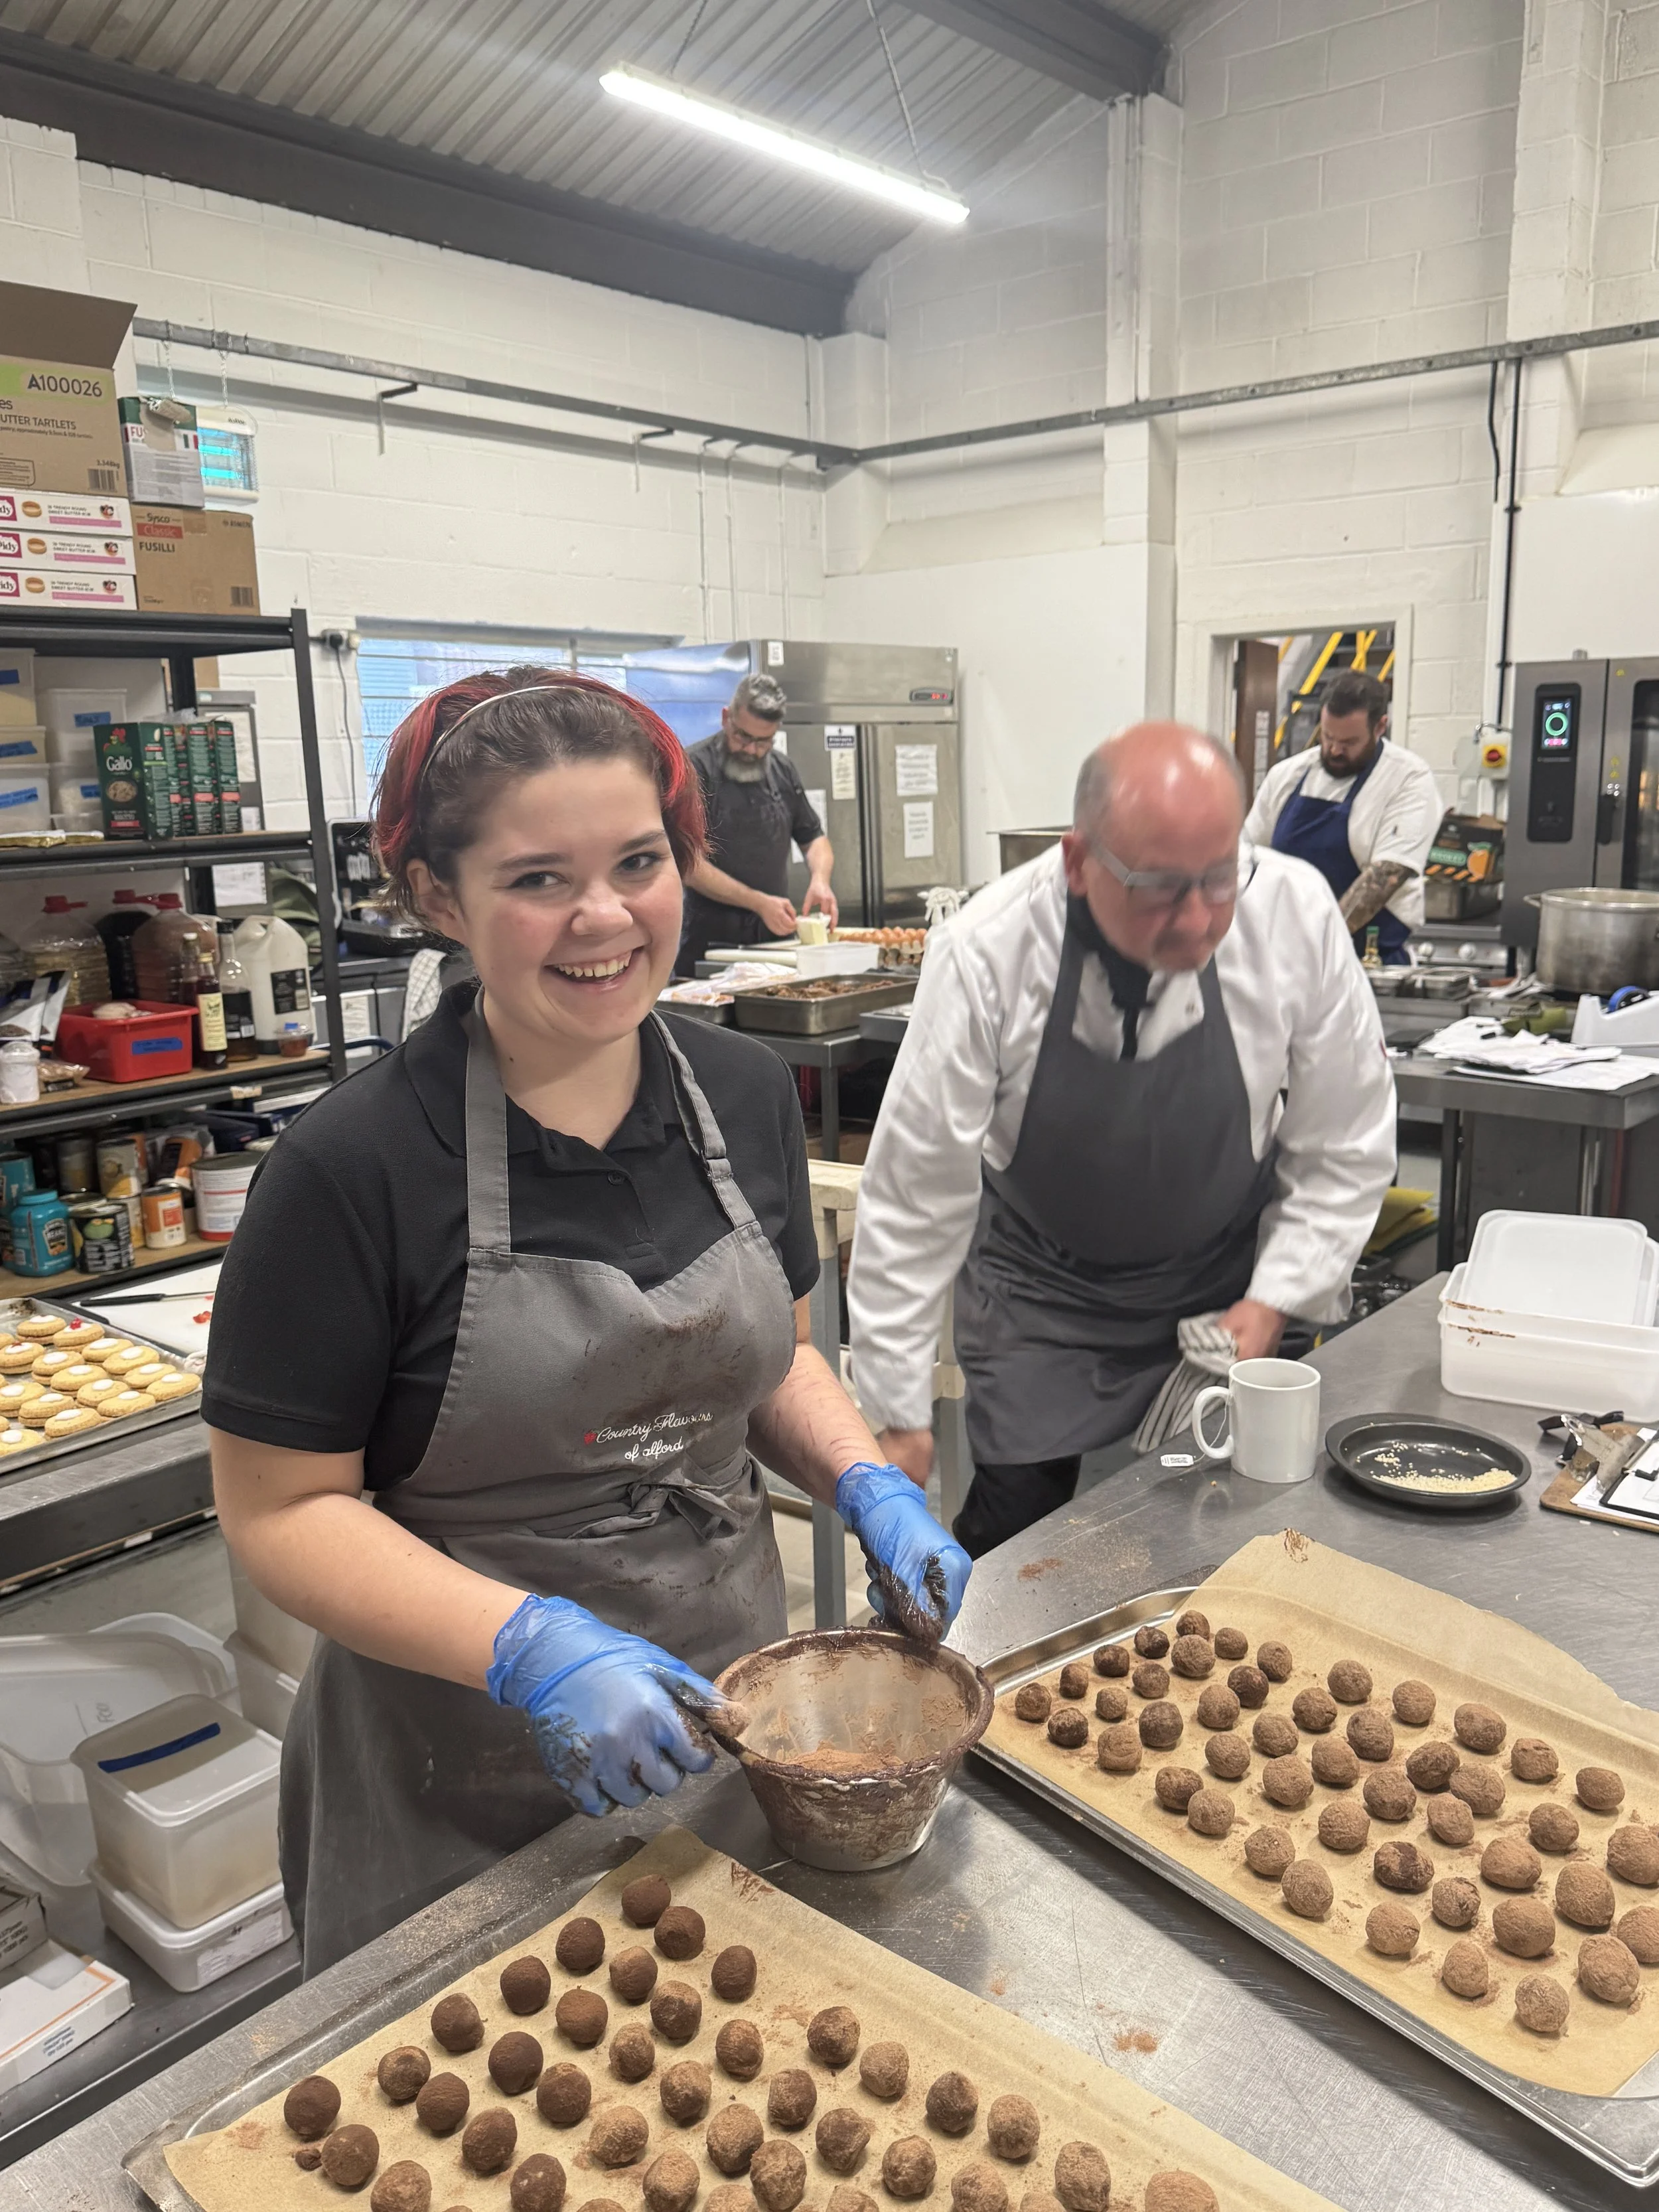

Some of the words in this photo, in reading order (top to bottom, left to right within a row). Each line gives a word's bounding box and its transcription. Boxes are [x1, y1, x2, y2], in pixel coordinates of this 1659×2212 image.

[27, 374, 102, 397] A100026
[33, 417, 77, 430] TARTLETS
[146, 512, 171, 524] Sysco
[144, 525, 176, 538] Classic
[139, 541, 175, 553] FUSILLI
[106, 755, 132, 772] Gallo
[597, 1423, 652, 1443] Country
[653, 1412, 713, 1432] Flavours
[624, 1443, 640, 1462] of
[642, 1436, 684, 1459] alford
